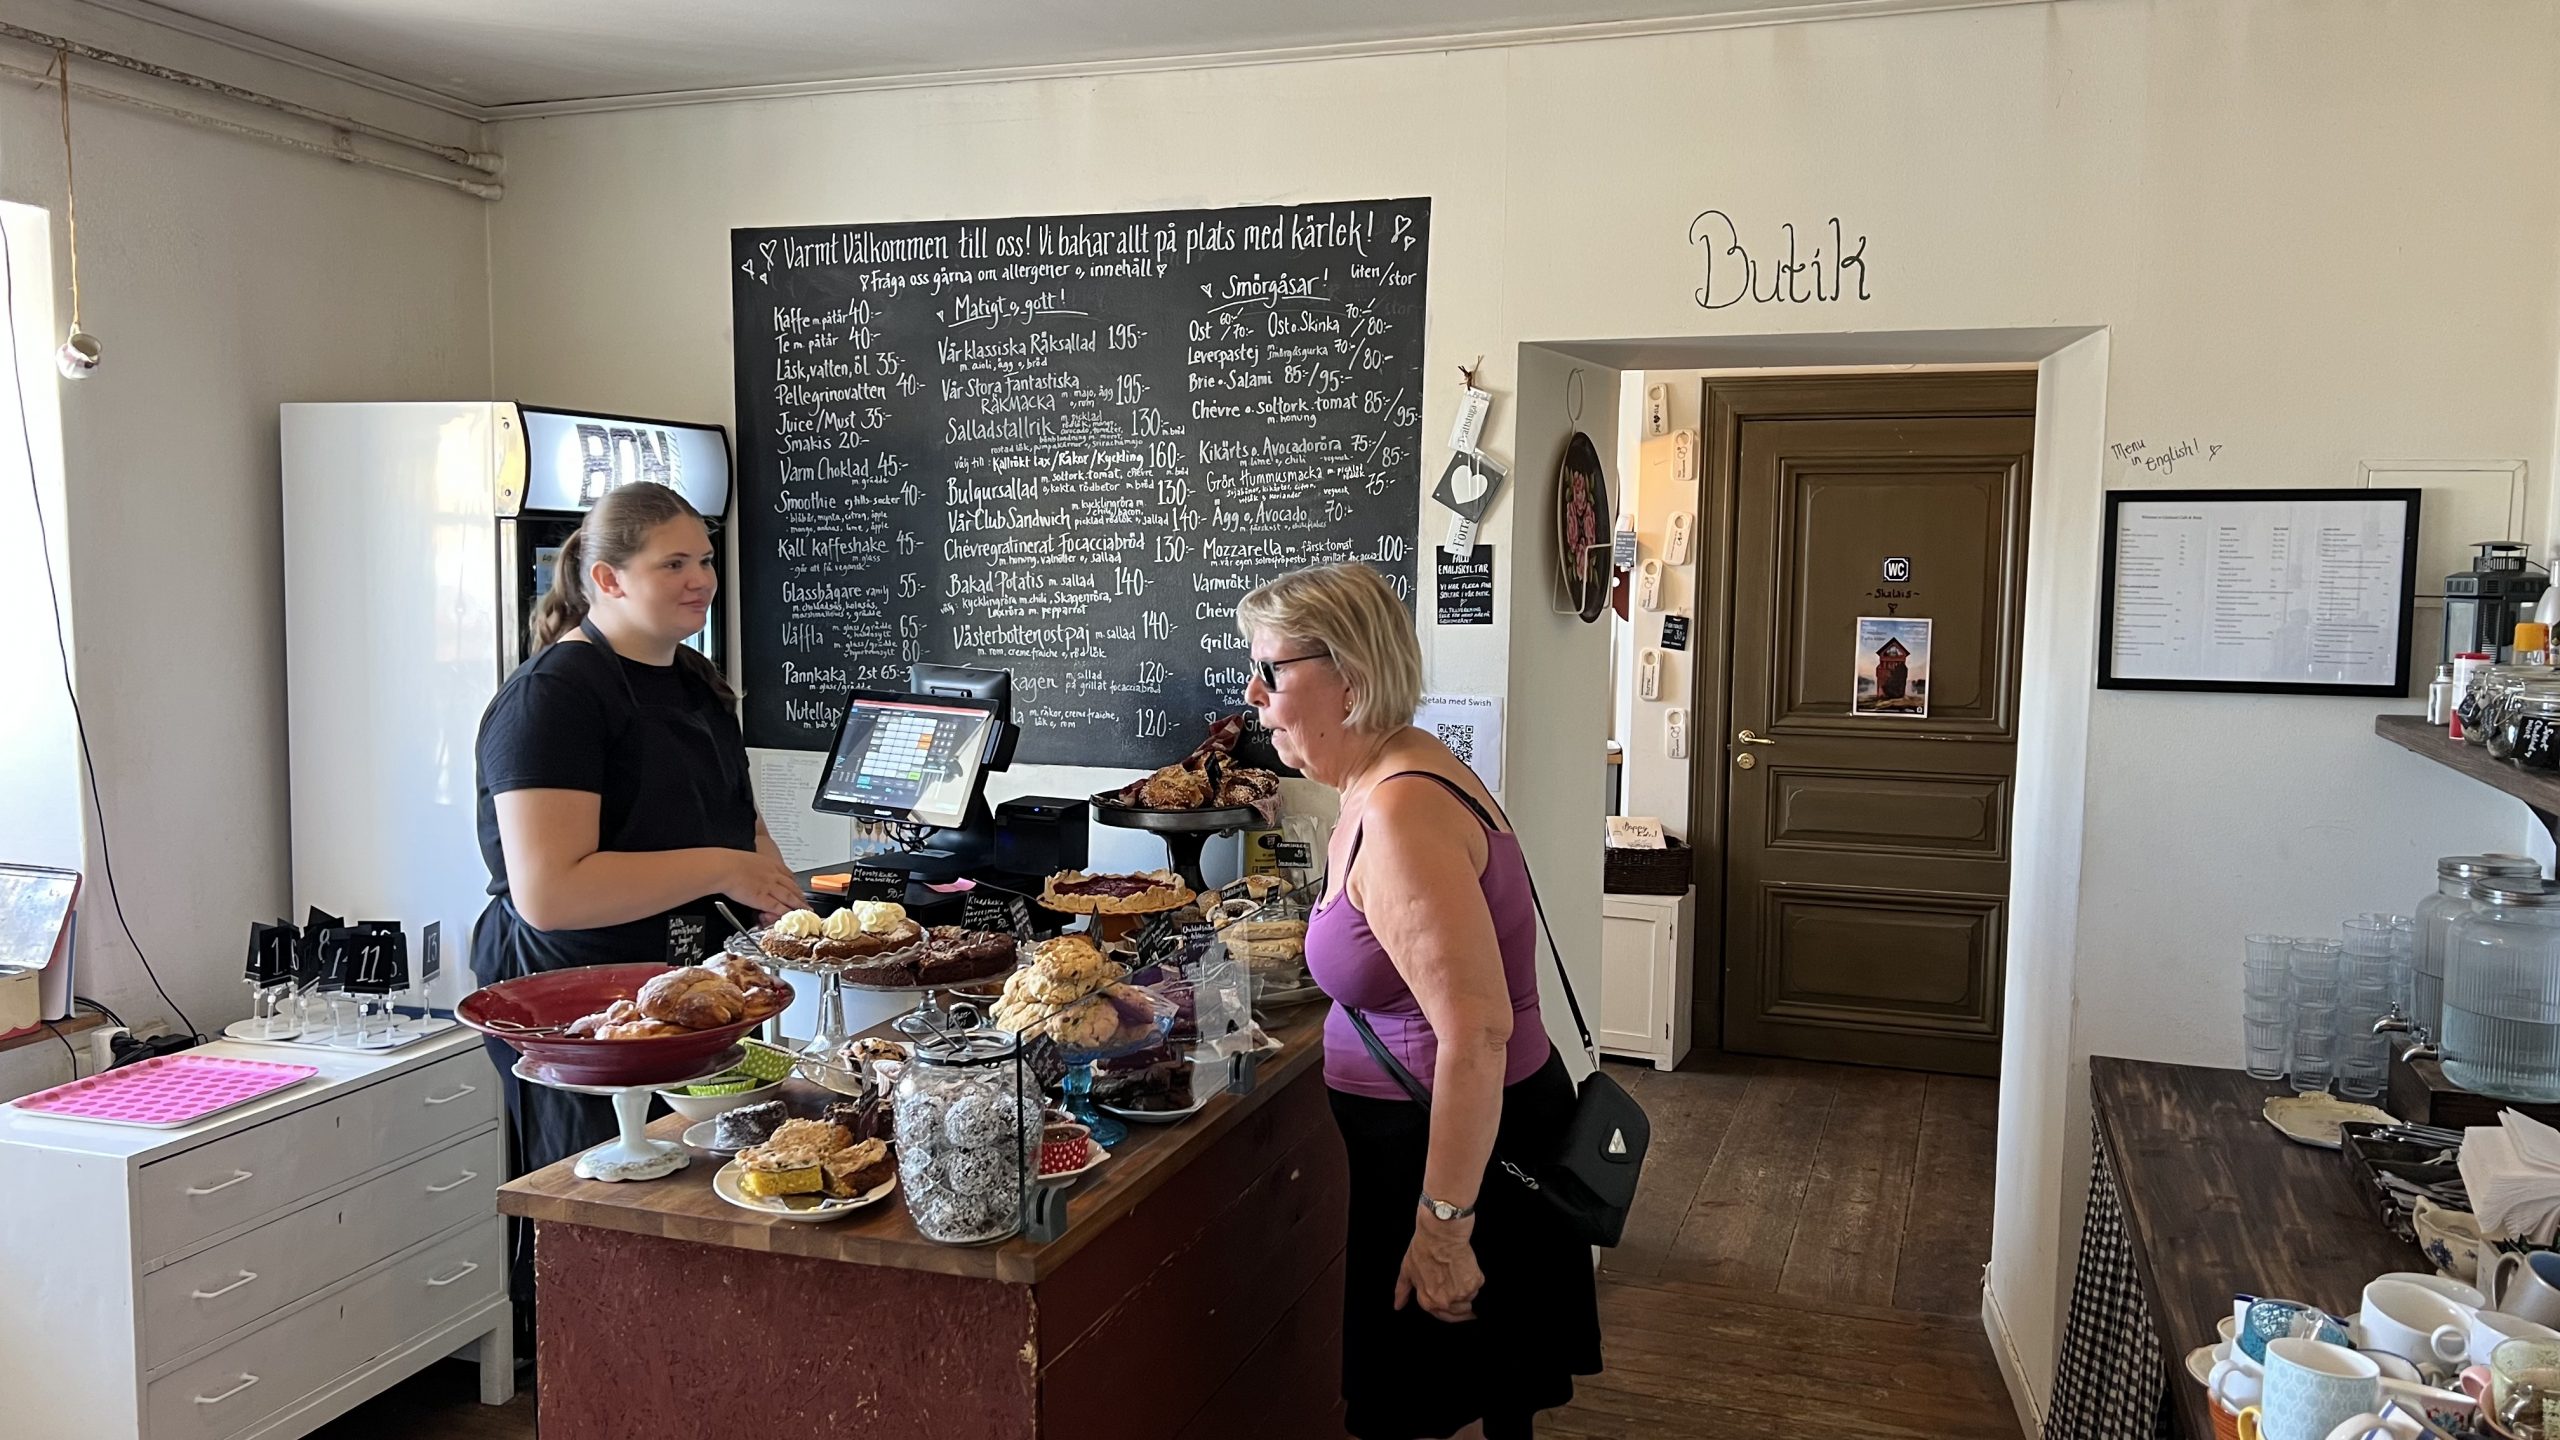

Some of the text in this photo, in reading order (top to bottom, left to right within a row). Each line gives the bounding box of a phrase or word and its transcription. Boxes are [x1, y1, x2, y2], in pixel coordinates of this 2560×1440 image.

[784, 211, 1374, 269] Varmt Välkommen till oss! Vi bakar allt på plats med kärlek!
[1689, 210, 1871, 310] Butik
[870, 258, 1152, 297] Fråga oss gärna om allergener innehåll
[774, 307, 810, 334] Kaffe
[849, 298, 882, 324] 40:-
[1189, 311, 1340, 341] Ost Ost Skinka
[775, 326, 881, 354] Te påtår 40:-
[938, 336, 962, 365] Vår
[965, 338, 1026, 360] klassiska
[1108, 324, 1148, 350] 195:-
[876, 352, 906, 376] 35:-
[998, 356, 1047, 372] ägg bröd
[1188, 344, 1258, 369] Leverpastej
[774, 372, 926, 416] Pellegrinovatten 40:-
[942, 374, 1150, 406] Vår Stora 195:-
[1099, 386, 1113, 400] ägg
[1189, 370, 1273, 392] Brie Salami
[861, 407, 892, 429] 35:-
[946, 416, 1055, 445] Salladstallrik
[1131, 408, 1169, 437] 130:-
[1281, 413, 1316, 428] honung
[777, 432, 869, 454] Smakis 20:-
[1200, 436, 1342, 463] Kikärts Avocadoröra
[2111, 439, 2146, 459] Menu
[780, 452, 908, 485] Varm Choklad 45:-
[992, 442, 1185, 476] Kallrökt 160:-
[1251, 455, 1306, 465] lime chili
[2131, 457, 2141, 466] in
[1206, 472, 1235, 493] Grön
[1240, 466, 1322, 485] Hummusmacka
[774, 490, 836, 513] Smoothie
[900, 481, 926, 507] 40:-
[946, 477, 1038, 512] Bulgursallad
[1079, 481, 1119, 492] rödbetor
[1135, 480, 1154, 489] bröd
[1158, 478, 1196, 506] 130:-
[1172, 504, 1208, 532] 140:-
[1213, 499, 1239, 532] Ägg
[1256, 501, 1307, 523] Avocado
[778, 530, 924, 561] Kall kaffeshake 45:-
[1090, 552, 1121, 564] sallad
[1154, 536, 1195, 563] 130:-
[1204, 535, 1413, 561] Mozzarella 100:-
[945, 567, 1154, 597] Bakad Potatis sallad 140:-
[1193, 573, 1251, 592] Varmrökt
[1888, 563, 1905, 576] WC
[782, 581, 862, 603] Glassbägare
[898, 573, 926, 598] 55:-
[988, 605, 1088, 619] Laxröra pepparrot
[1107, 610, 1178, 641] sallad 140:-
[782, 615, 927, 653] Våffla 65:-
[903, 640, 930, 662] 80:-
[782, 661, 846, 685] Pannkaka
[1077, 661, 1173, 684] sallad 120:-
[1066, 681, 1077, 693] på
[1080, 681, 1107, 697] grillat
[1469, 699, 1491, 707] Swish
[1035, 717, 1075, 728] lök rom
[1136, 708, 1180, 738] 120:-
